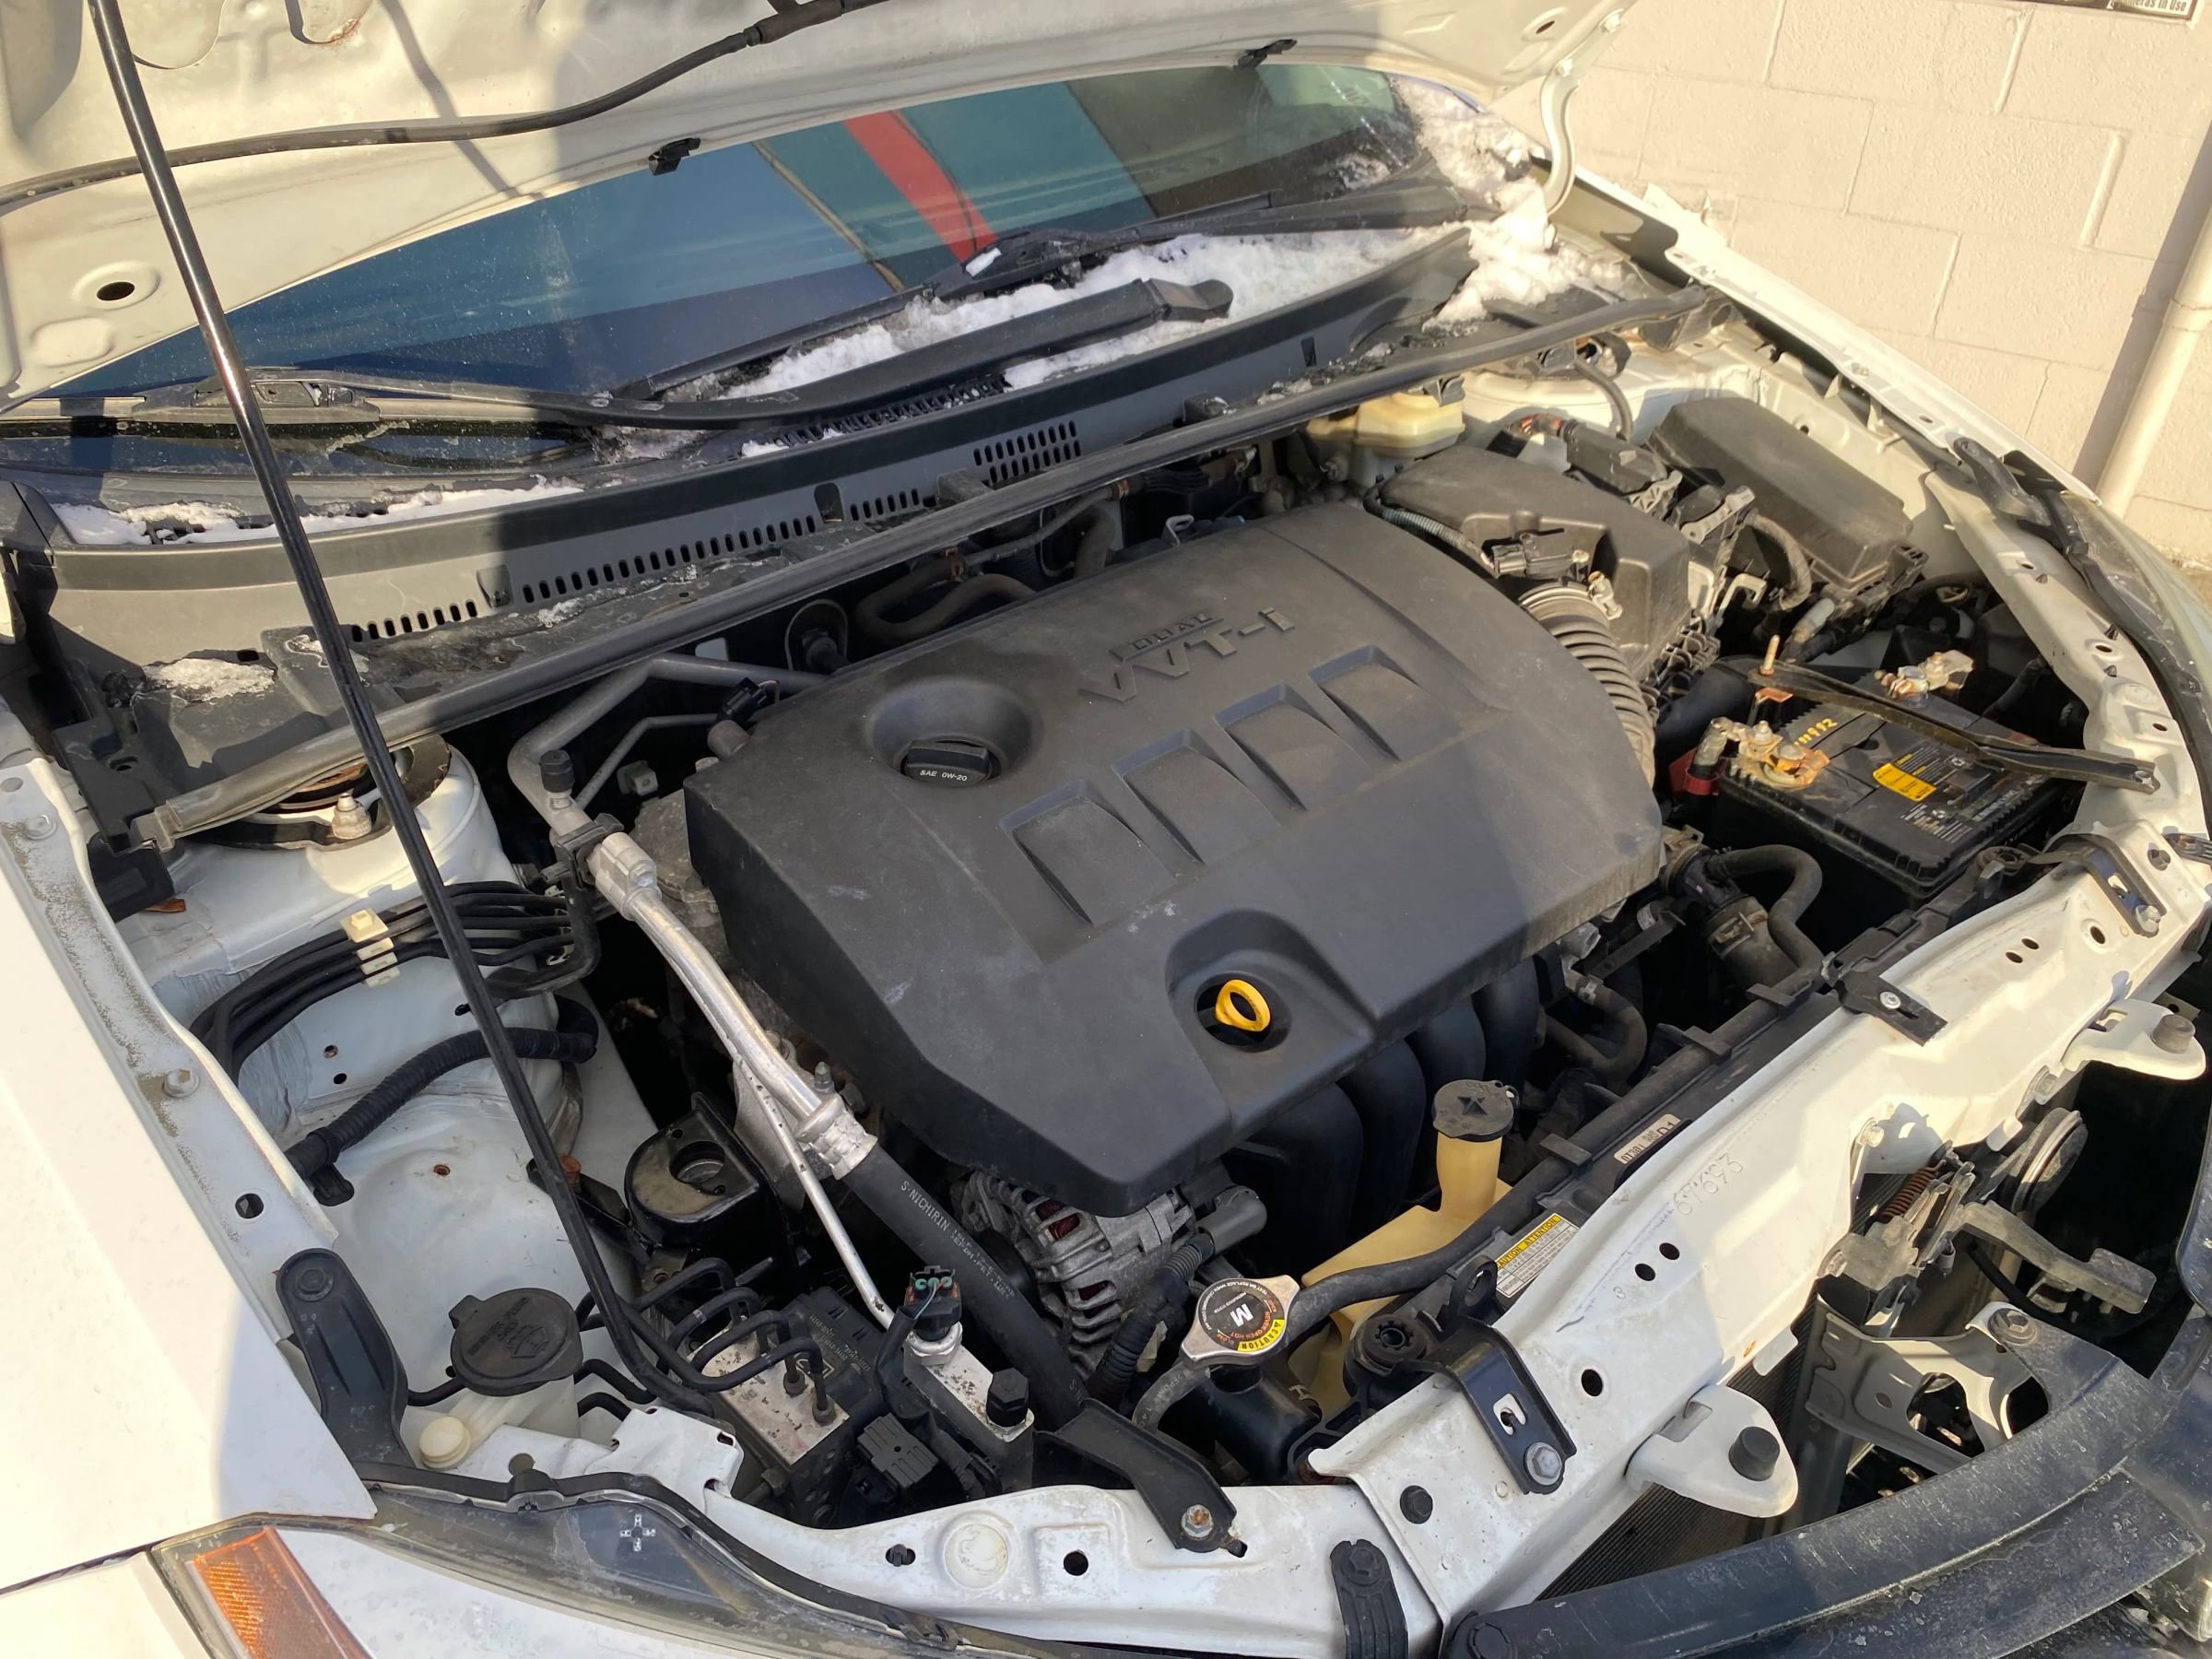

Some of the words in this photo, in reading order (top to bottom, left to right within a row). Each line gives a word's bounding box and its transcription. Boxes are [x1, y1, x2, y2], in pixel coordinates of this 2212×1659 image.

[2170, 0, 2187, 11] Use
[1130, 613, 1213, 650] DUAL
[941, 772, 968, 782] 0W-20
[1525, 1218, 1558, 1246] ATTENTION
[1241, 1328, 1279, 1349] CAUTION
